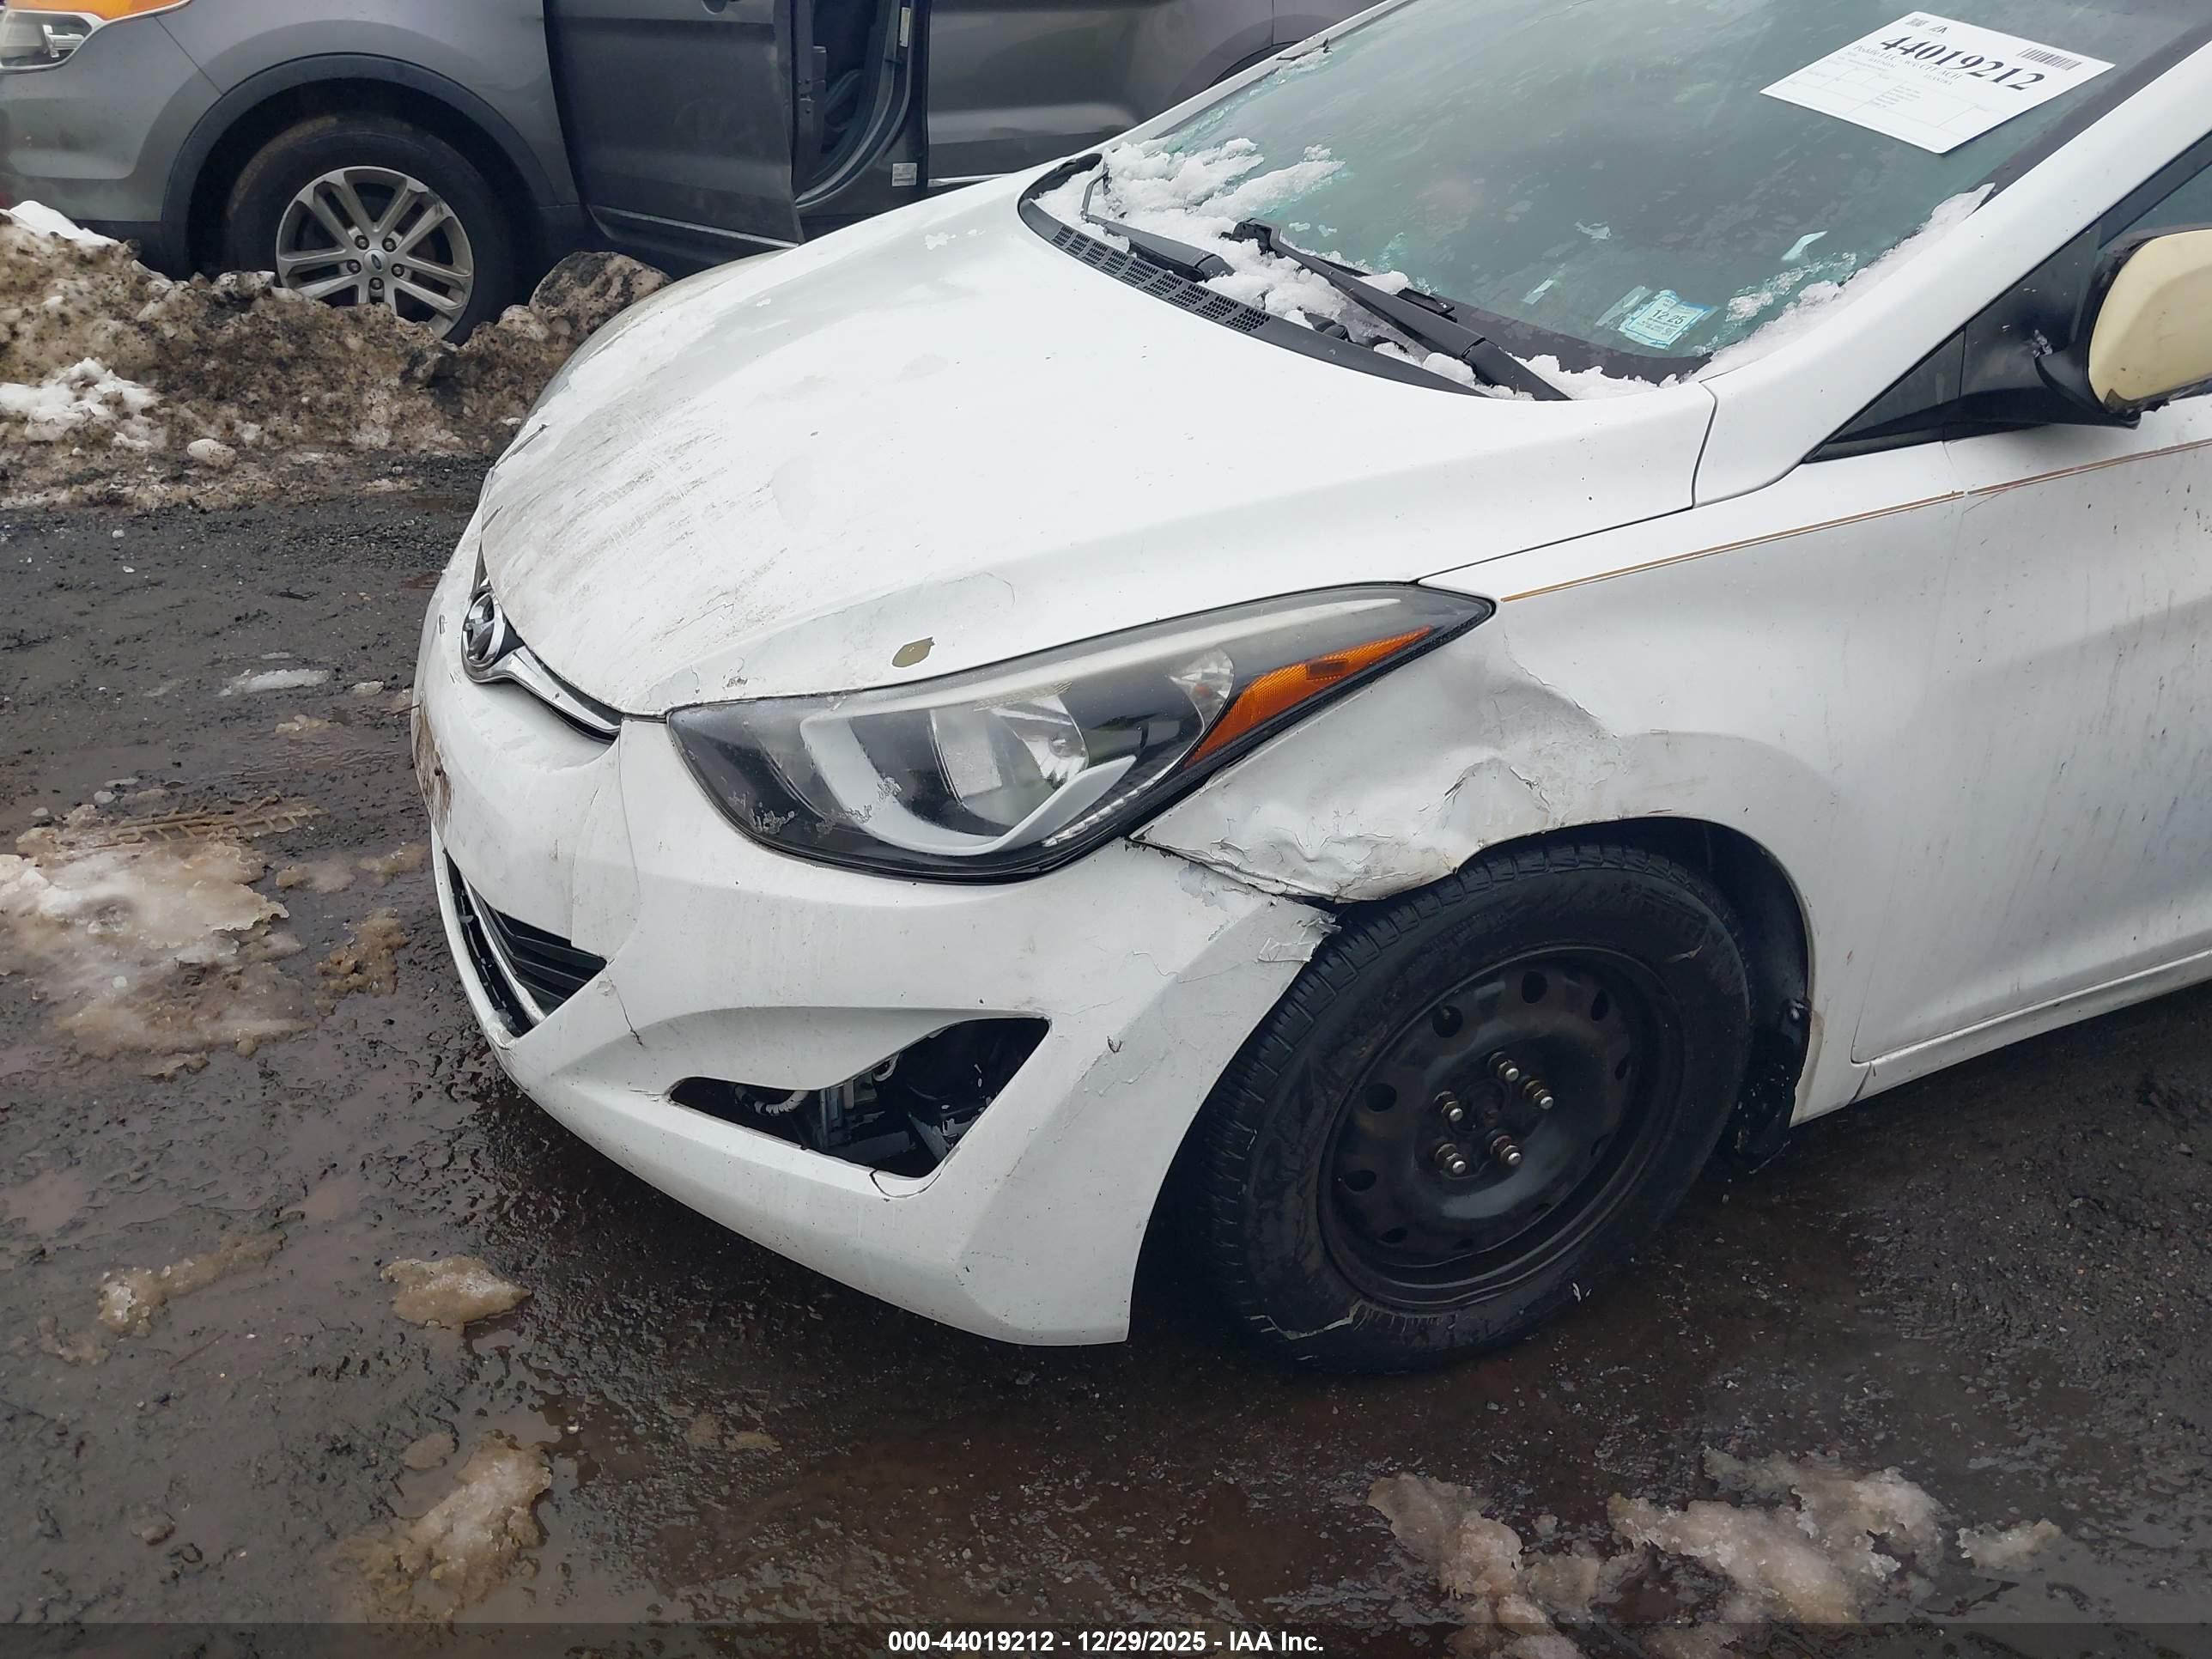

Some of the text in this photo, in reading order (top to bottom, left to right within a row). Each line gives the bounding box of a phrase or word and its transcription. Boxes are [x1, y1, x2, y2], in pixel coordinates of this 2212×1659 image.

[1880, 36, 2045, 90] 44019212
[1652, 309, 1687, 325] 12 25
